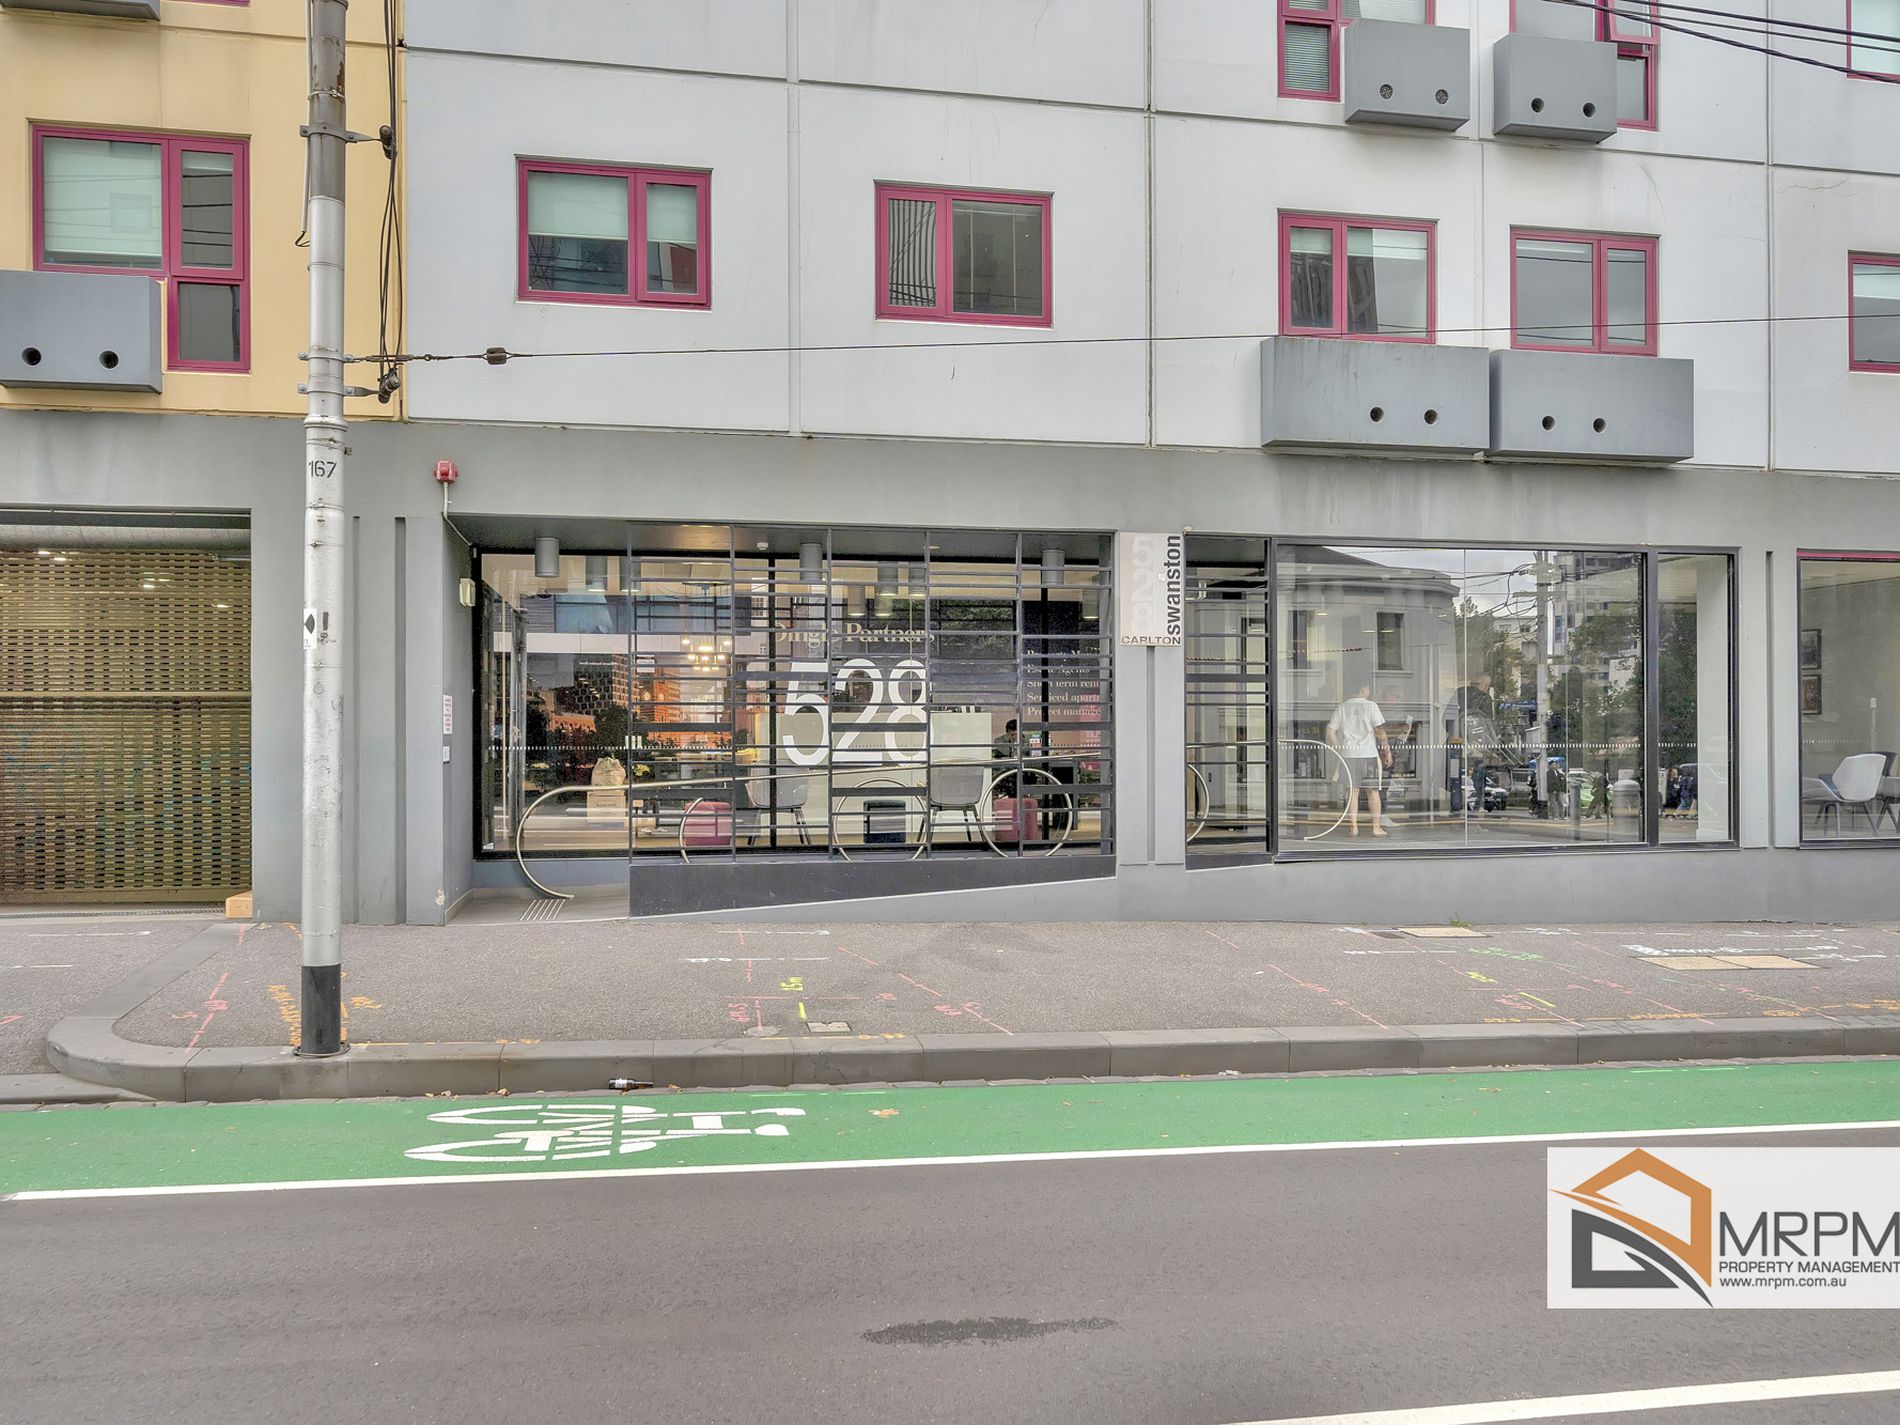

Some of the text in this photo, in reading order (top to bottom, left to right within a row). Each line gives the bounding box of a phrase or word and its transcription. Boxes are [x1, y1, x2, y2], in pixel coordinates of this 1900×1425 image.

[308, 460, 337, 478] 167
[1164, 535, 1181, 636] swanston
[1121, 636, 1181, 645] CARLTON
[1027, 691, 1069, 701] Sericed
[782, 658, 934, 766] 528
